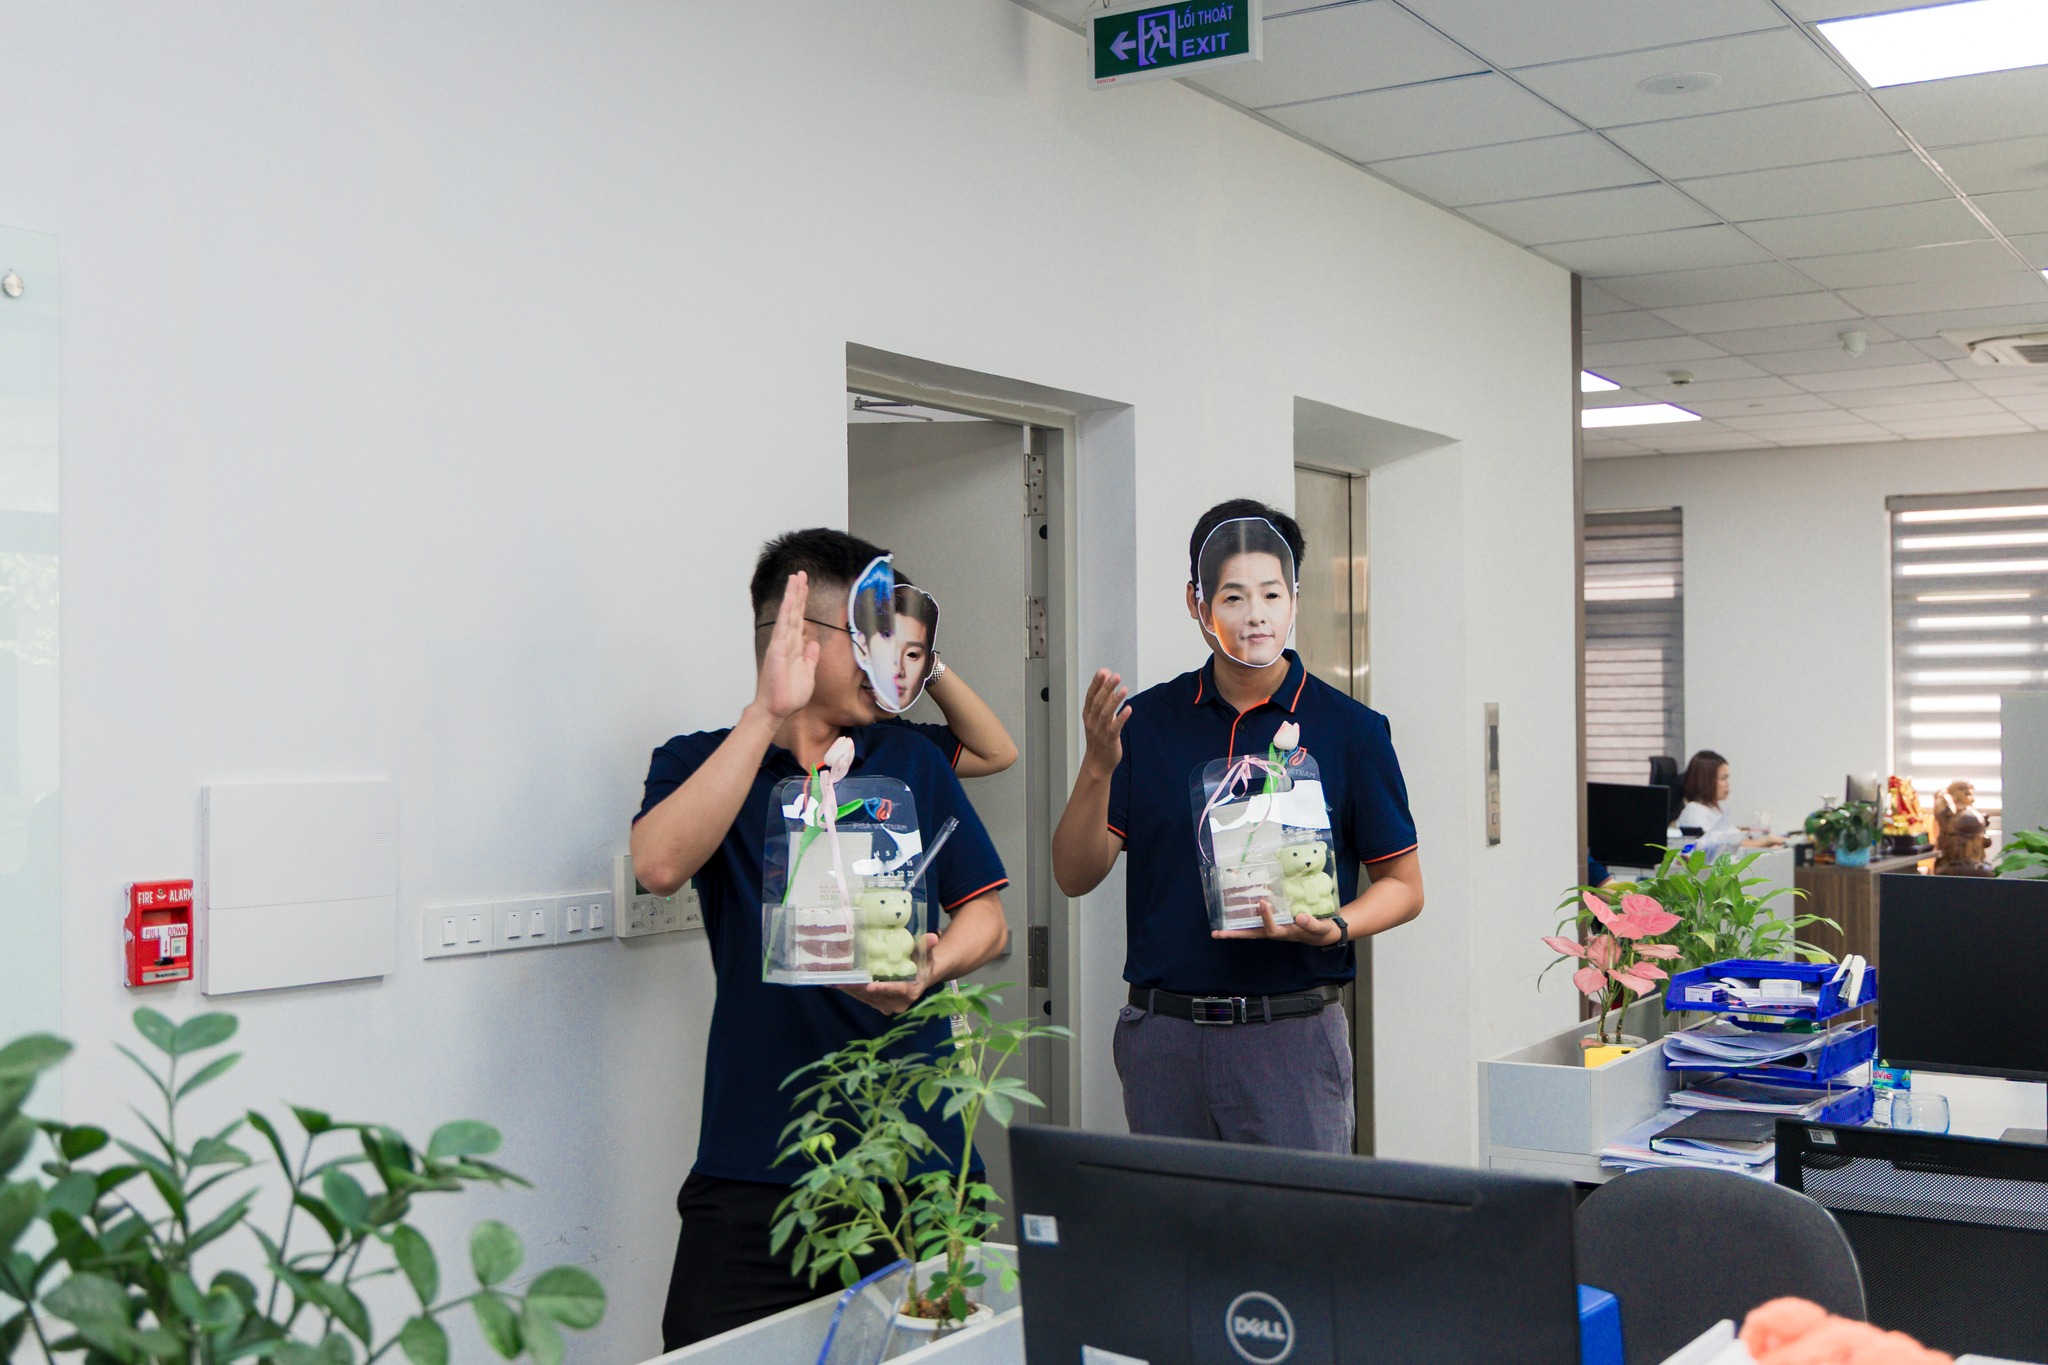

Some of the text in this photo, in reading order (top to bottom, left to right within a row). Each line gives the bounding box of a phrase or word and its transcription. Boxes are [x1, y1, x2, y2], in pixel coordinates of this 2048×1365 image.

[1177, 3, 1233, 29] LỐI THOÁT
[1183, 33, 1230, 57] EXIT
[1287, 767, 1316, 778] IETNAM
[138, 888, 194, 905] FIRE ALARM
[145, 926, 187, 938] PULL DOWN
[1873, 1070, 1893, 1080] aVie
[1234, 1316, 1286, 1340] DELL
